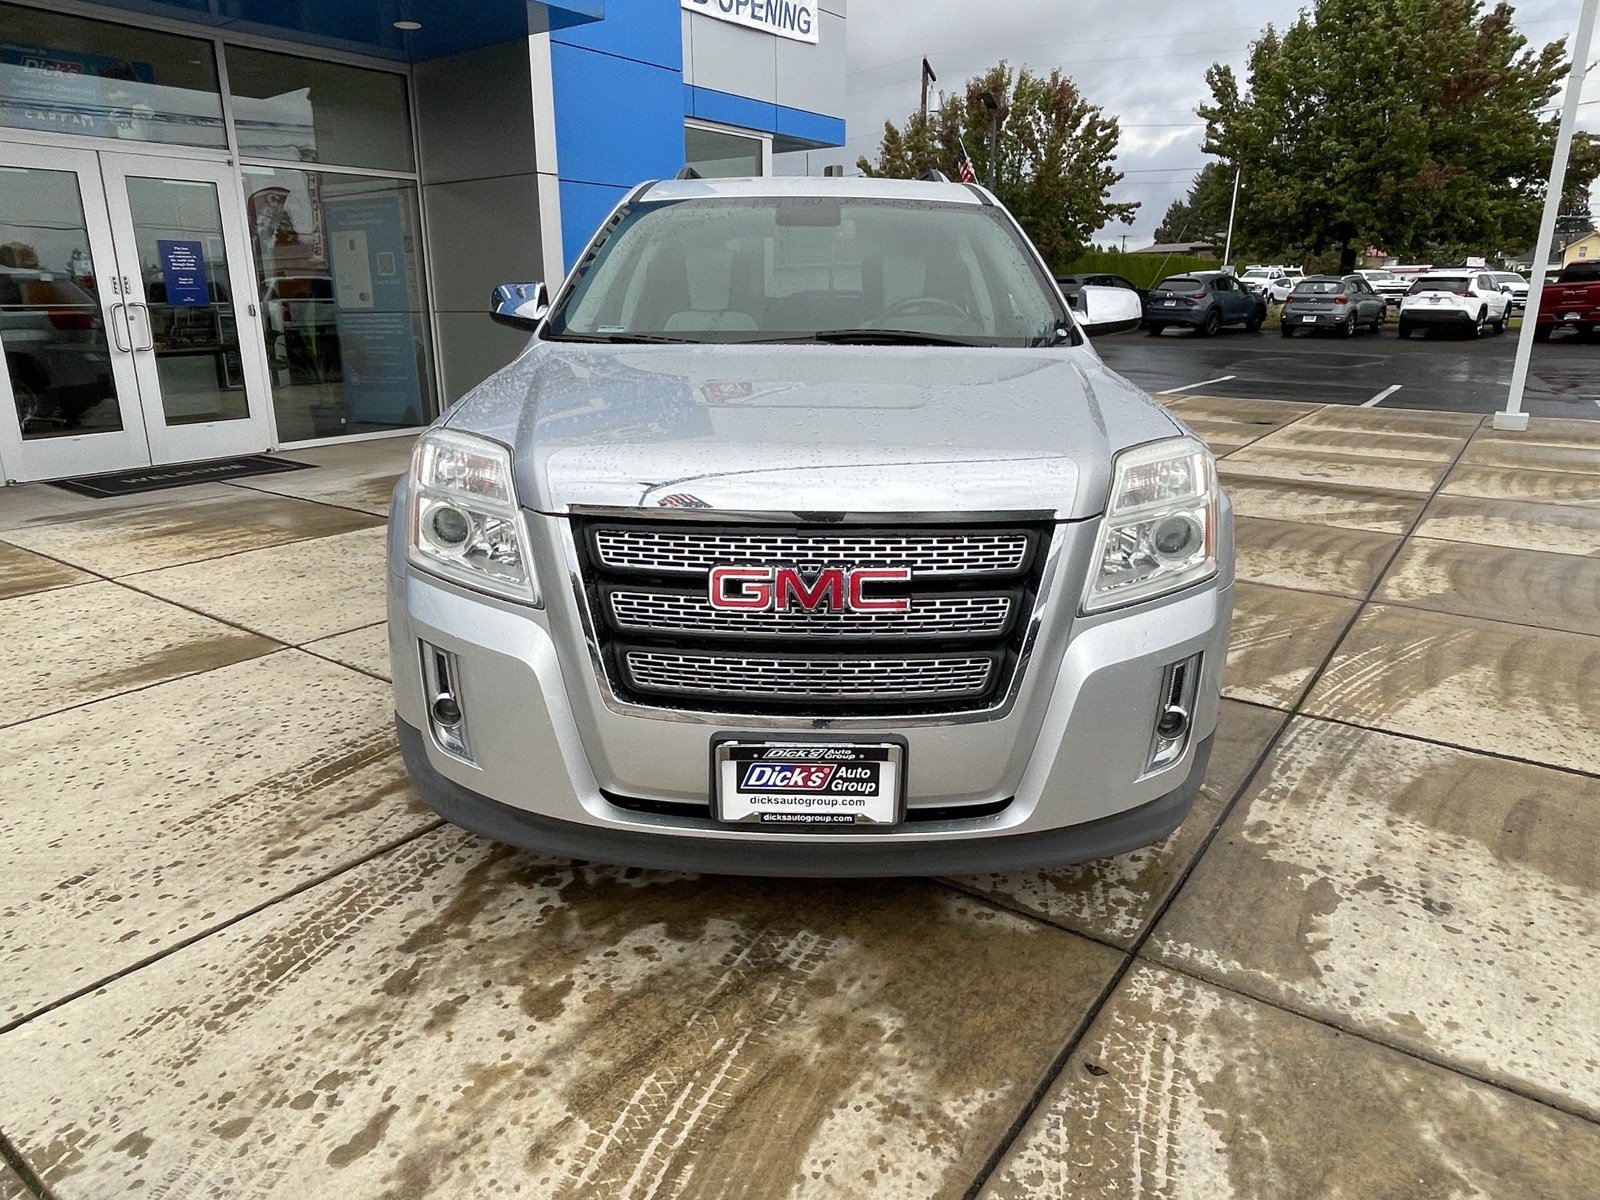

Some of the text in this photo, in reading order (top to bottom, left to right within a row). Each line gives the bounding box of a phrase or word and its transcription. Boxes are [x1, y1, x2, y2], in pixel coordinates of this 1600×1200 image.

[709, 565, 911, 611] GMC
[749, 765, 876, 794] Dick's Auto Group
[750, 796, 866, 807] dicksautogroup.com
[763, 814, 853, 822] dicksautogroup.com
